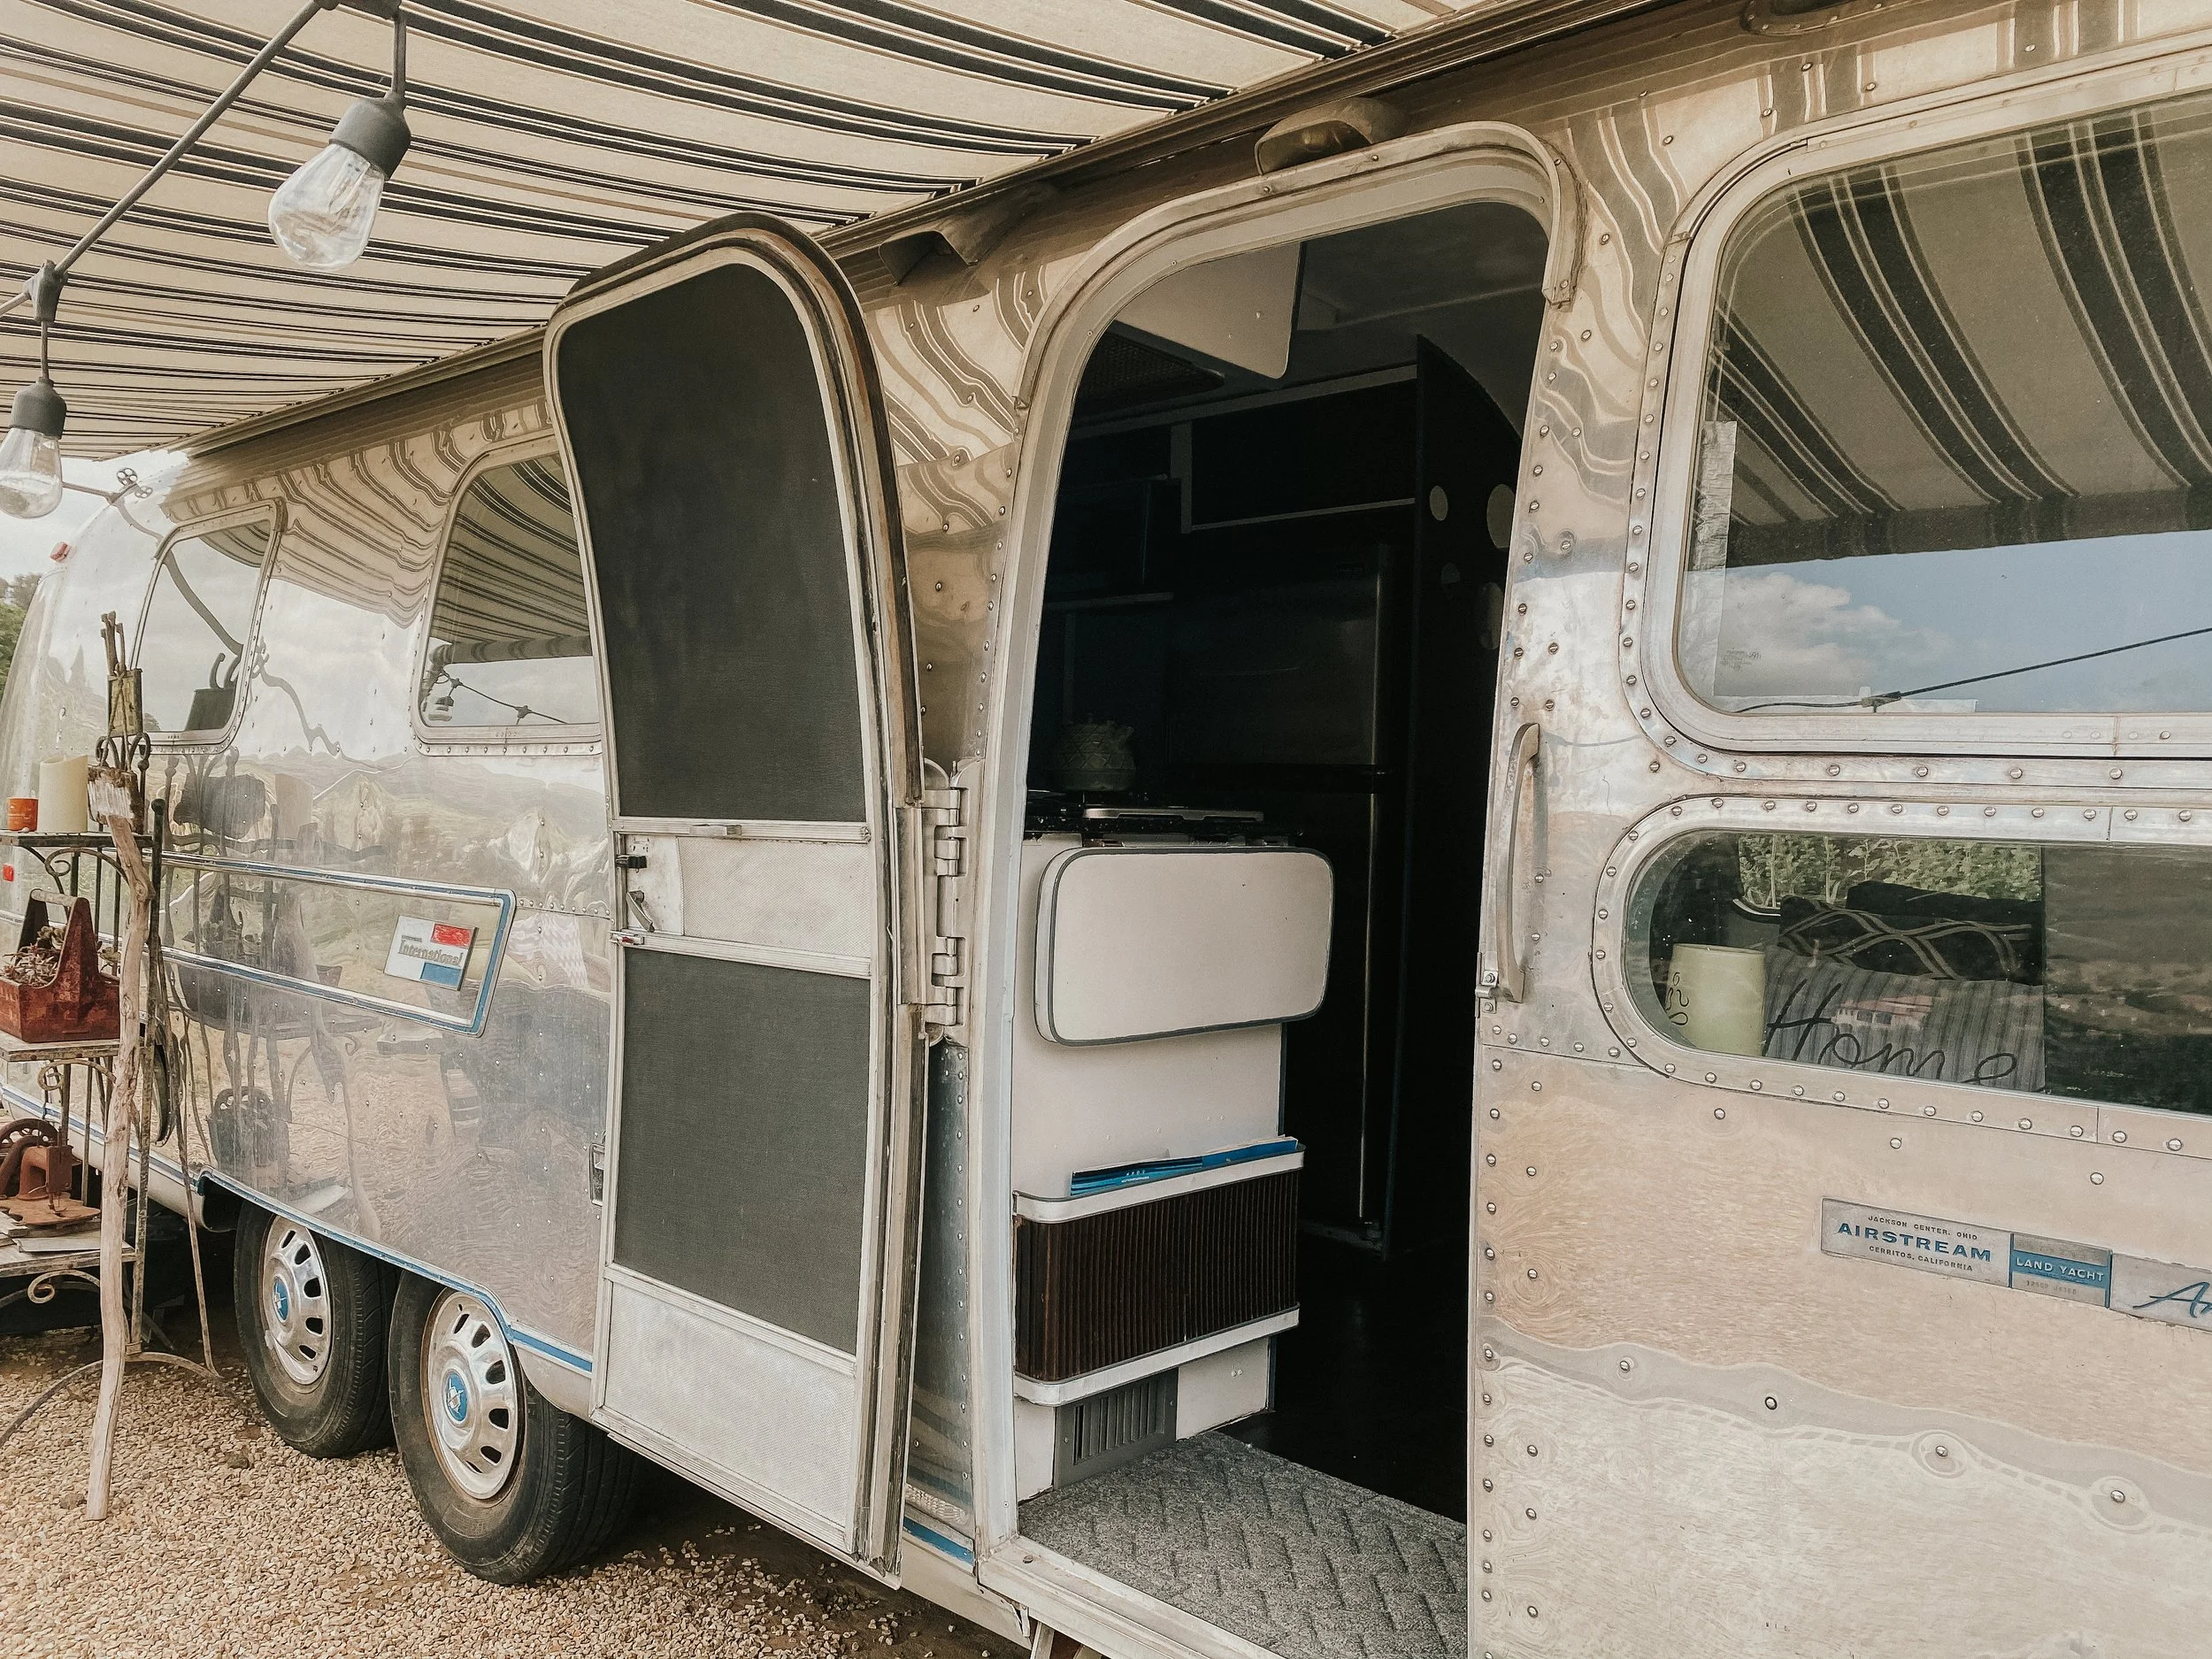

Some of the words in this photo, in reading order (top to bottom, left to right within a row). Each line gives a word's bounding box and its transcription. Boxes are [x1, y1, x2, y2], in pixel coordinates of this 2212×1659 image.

[398, 939, 465, 967] International
[1763, 978, 2017, 1086] Home
[1868, 1215, 1908, 1228] JACKSON
[1956, 1231, 1978, 1240] OHIO
[1837, 1222, 1991, 1263] AIRSTREAM
[1917, 1255, 1974, 1272] CALIFORNIA
[2016, 1256, 2054, 1272] LAND
[2059, 1264, 2104, 1282] YACHT
